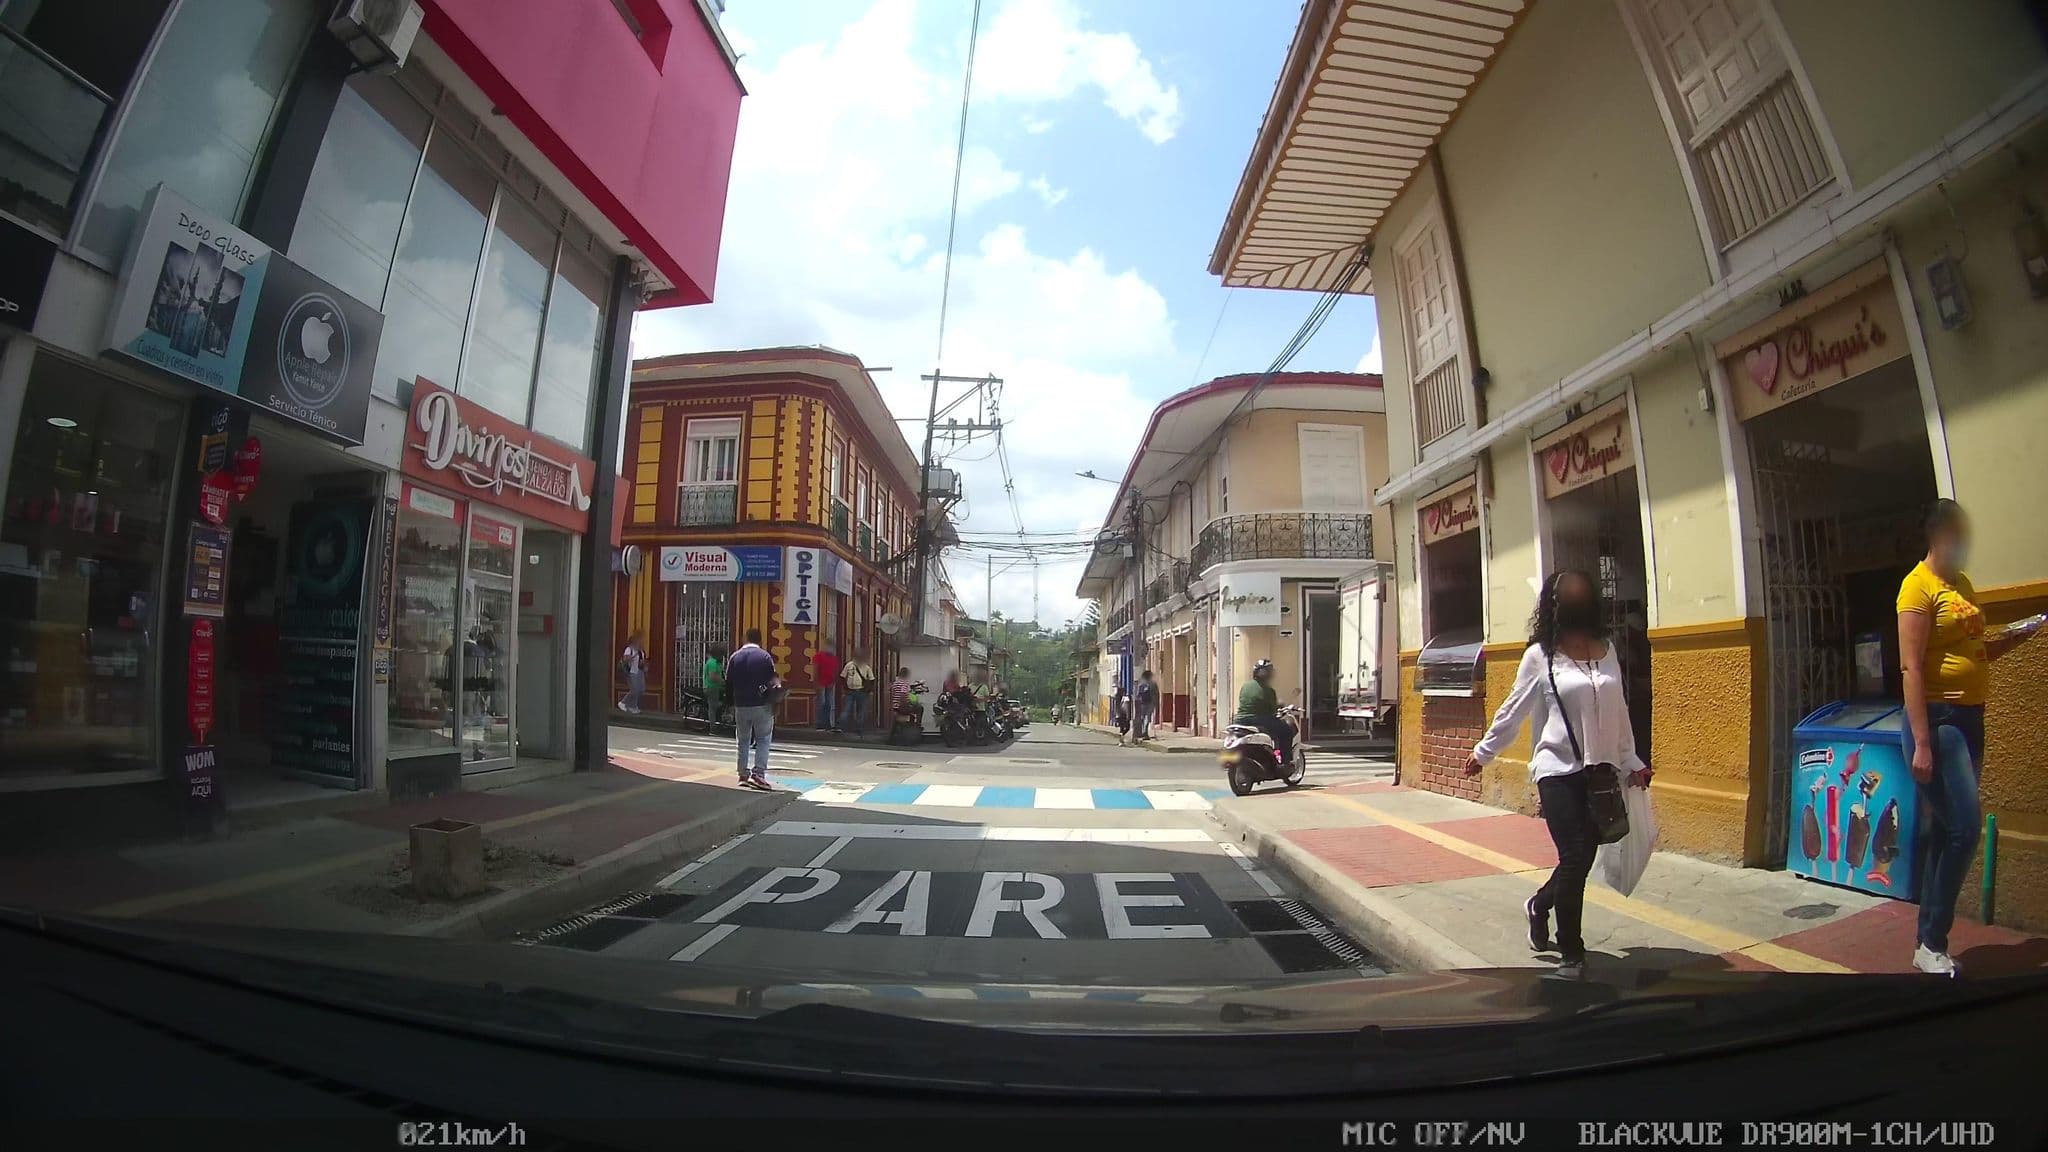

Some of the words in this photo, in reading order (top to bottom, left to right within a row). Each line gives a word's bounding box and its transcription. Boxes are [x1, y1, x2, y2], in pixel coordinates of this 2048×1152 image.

[177, 211, 211, 242] Deco
[214, 236, 256, 266] Glass
[1786, 304, 1886, 380] Chiqui's
[268, 394, 308, 417] Servicio
[308, 408, 338, 430] Ténico
[379, 519, 393, 622] RECARGAS
[685, 551, 727, 563] Visual
[685, 563, 727, 572] Moderna
[793, 550, 813, 622] OPTICA
[185, 750, 216, 772] WOM
[693, 866, 1213, 940] PARE
